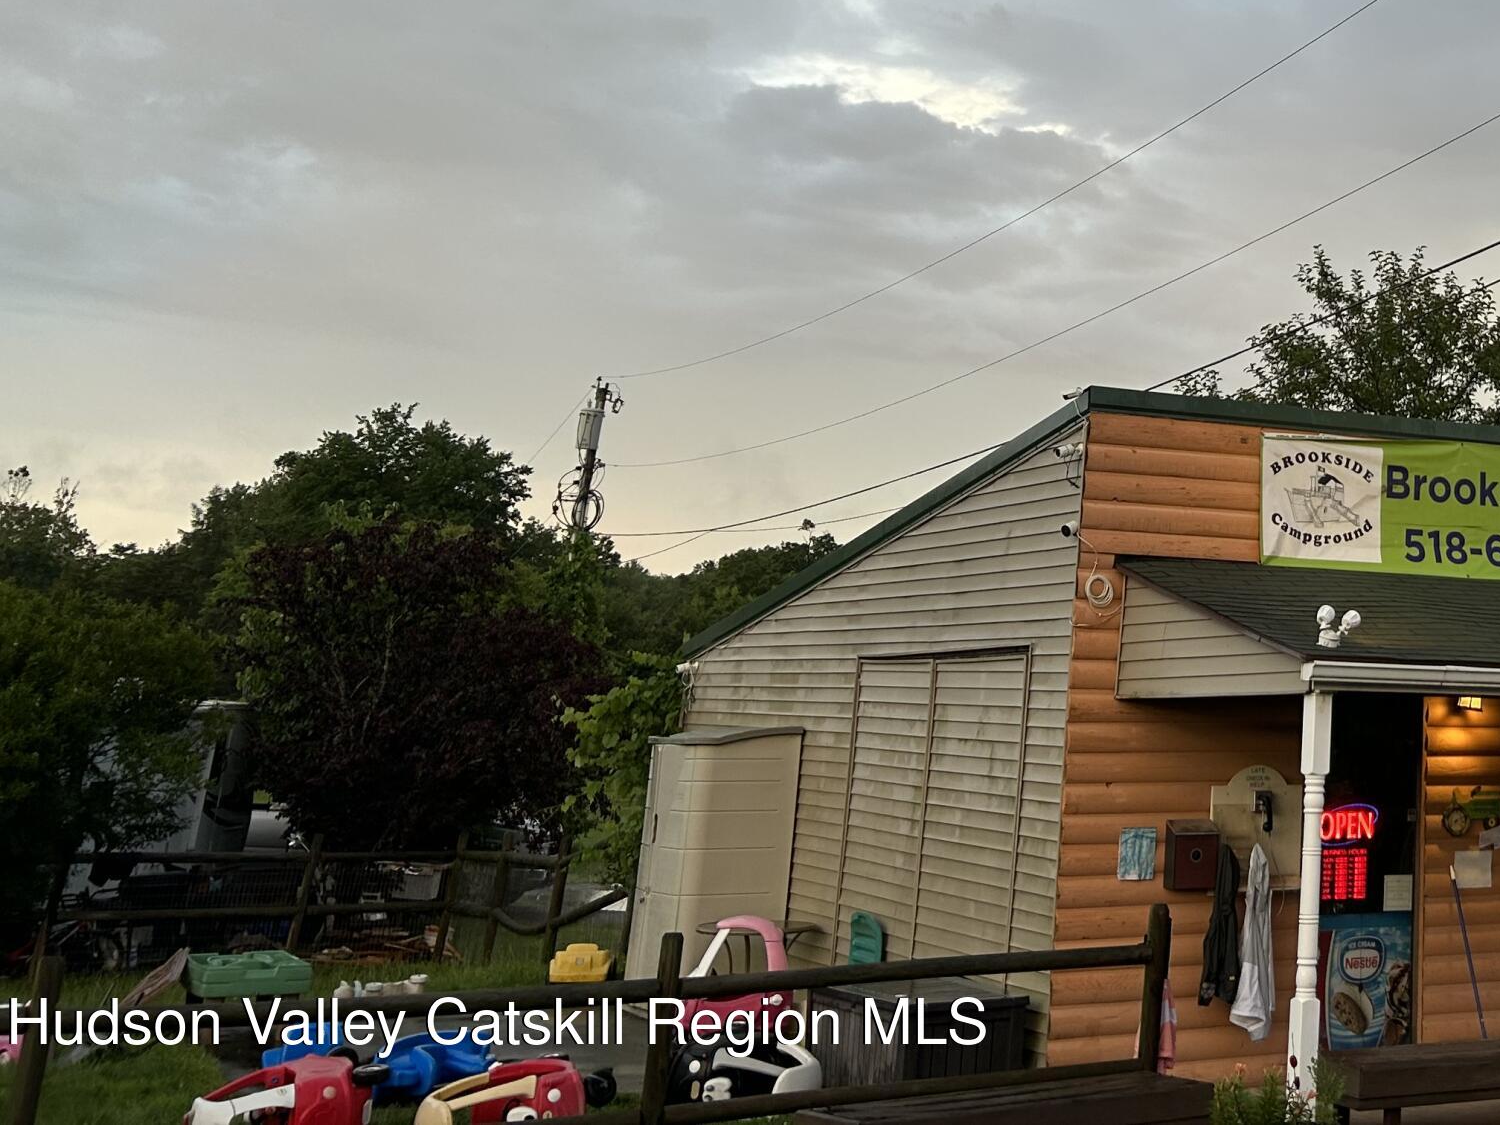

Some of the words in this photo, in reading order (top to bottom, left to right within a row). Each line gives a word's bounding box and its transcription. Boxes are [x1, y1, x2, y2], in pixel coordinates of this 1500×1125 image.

[1270, 452, 1374, 483] BROOKSIDE
[1272, 513, 1373, 546] Campground
[1320, 811, 1374, 841] OPEN
